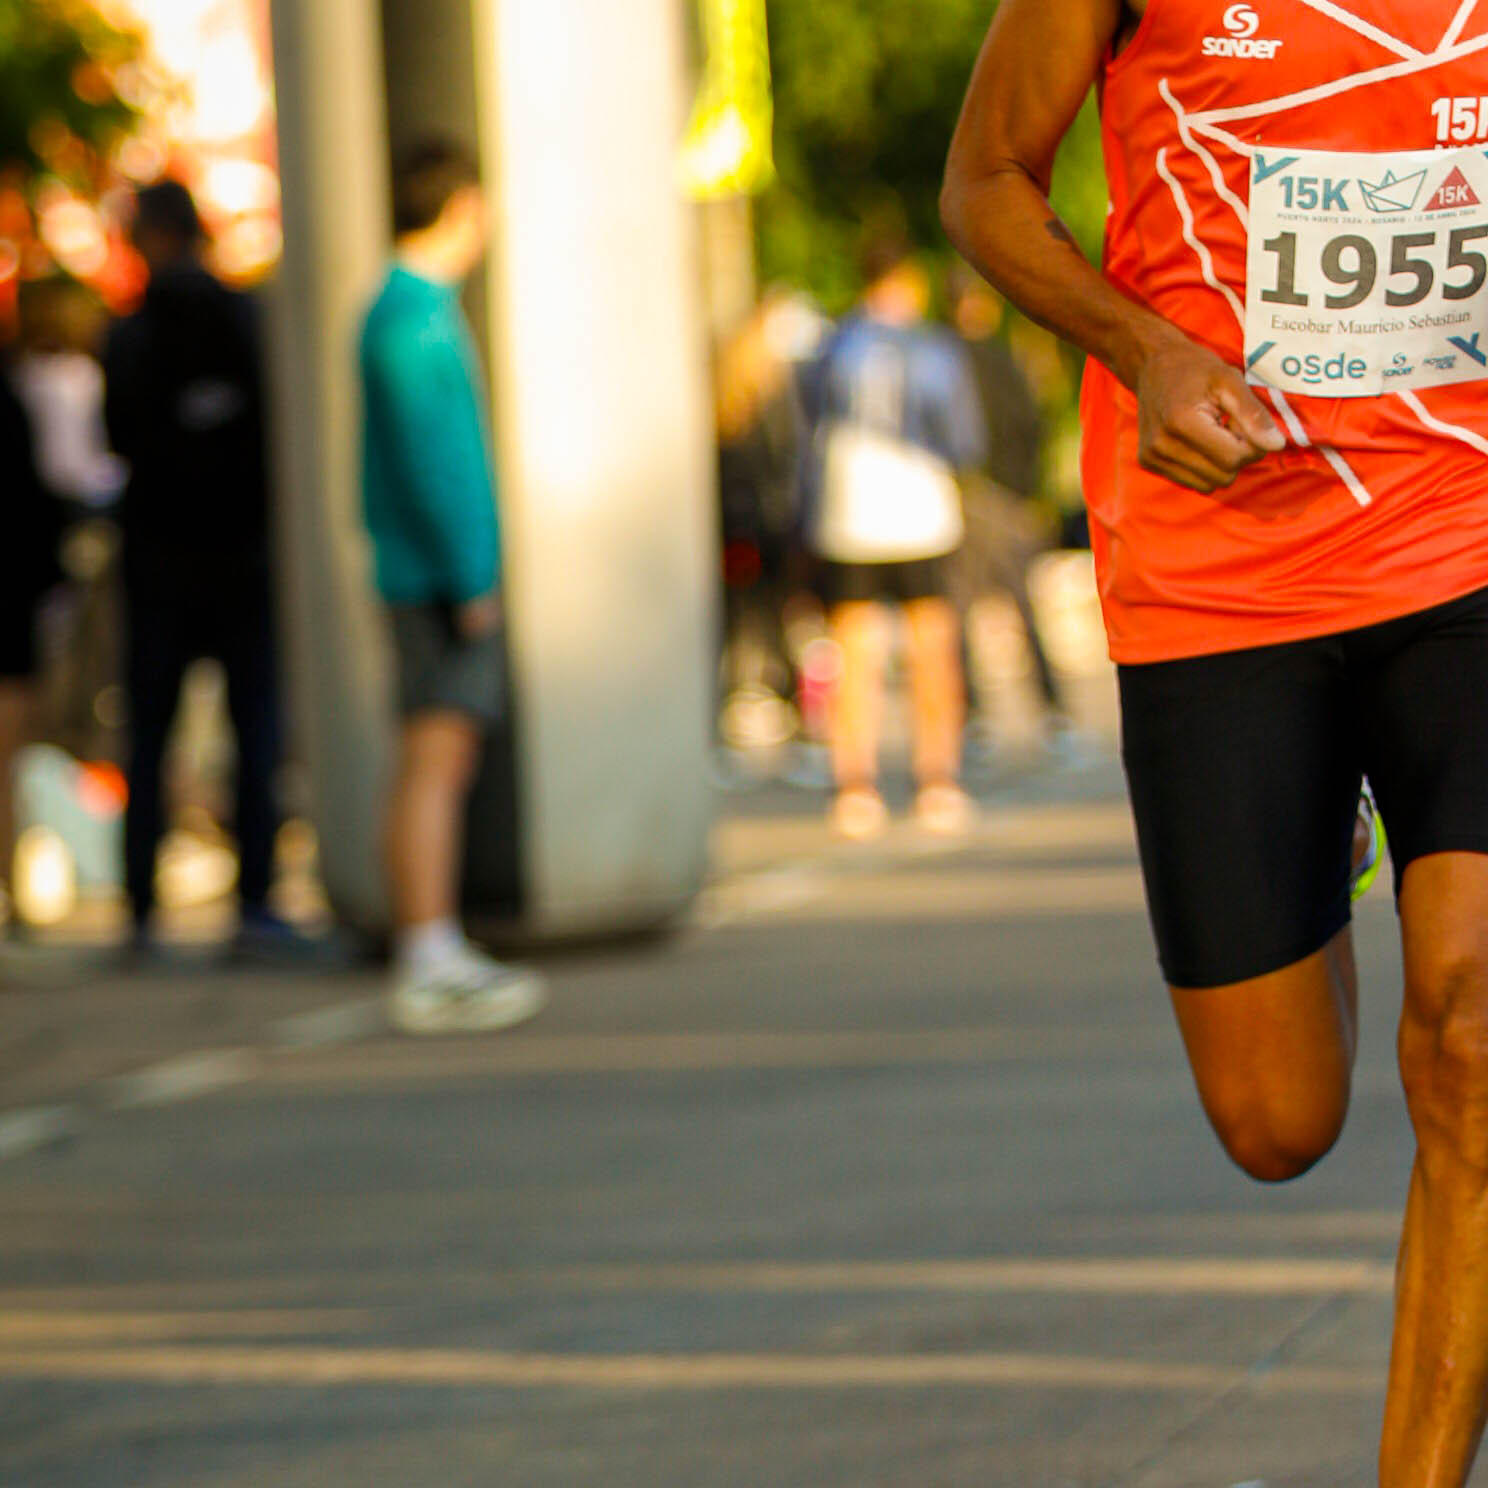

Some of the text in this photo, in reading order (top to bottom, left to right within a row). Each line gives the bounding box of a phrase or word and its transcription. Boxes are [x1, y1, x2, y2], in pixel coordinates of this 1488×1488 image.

[1278, 175, 1352, 212] 15K
[1436, 183, 1471, 206] 15K
[1271, 310, 1471, 335] Escobar Mauricio Sebastian
[1281, 352, 1368, 382] osde
